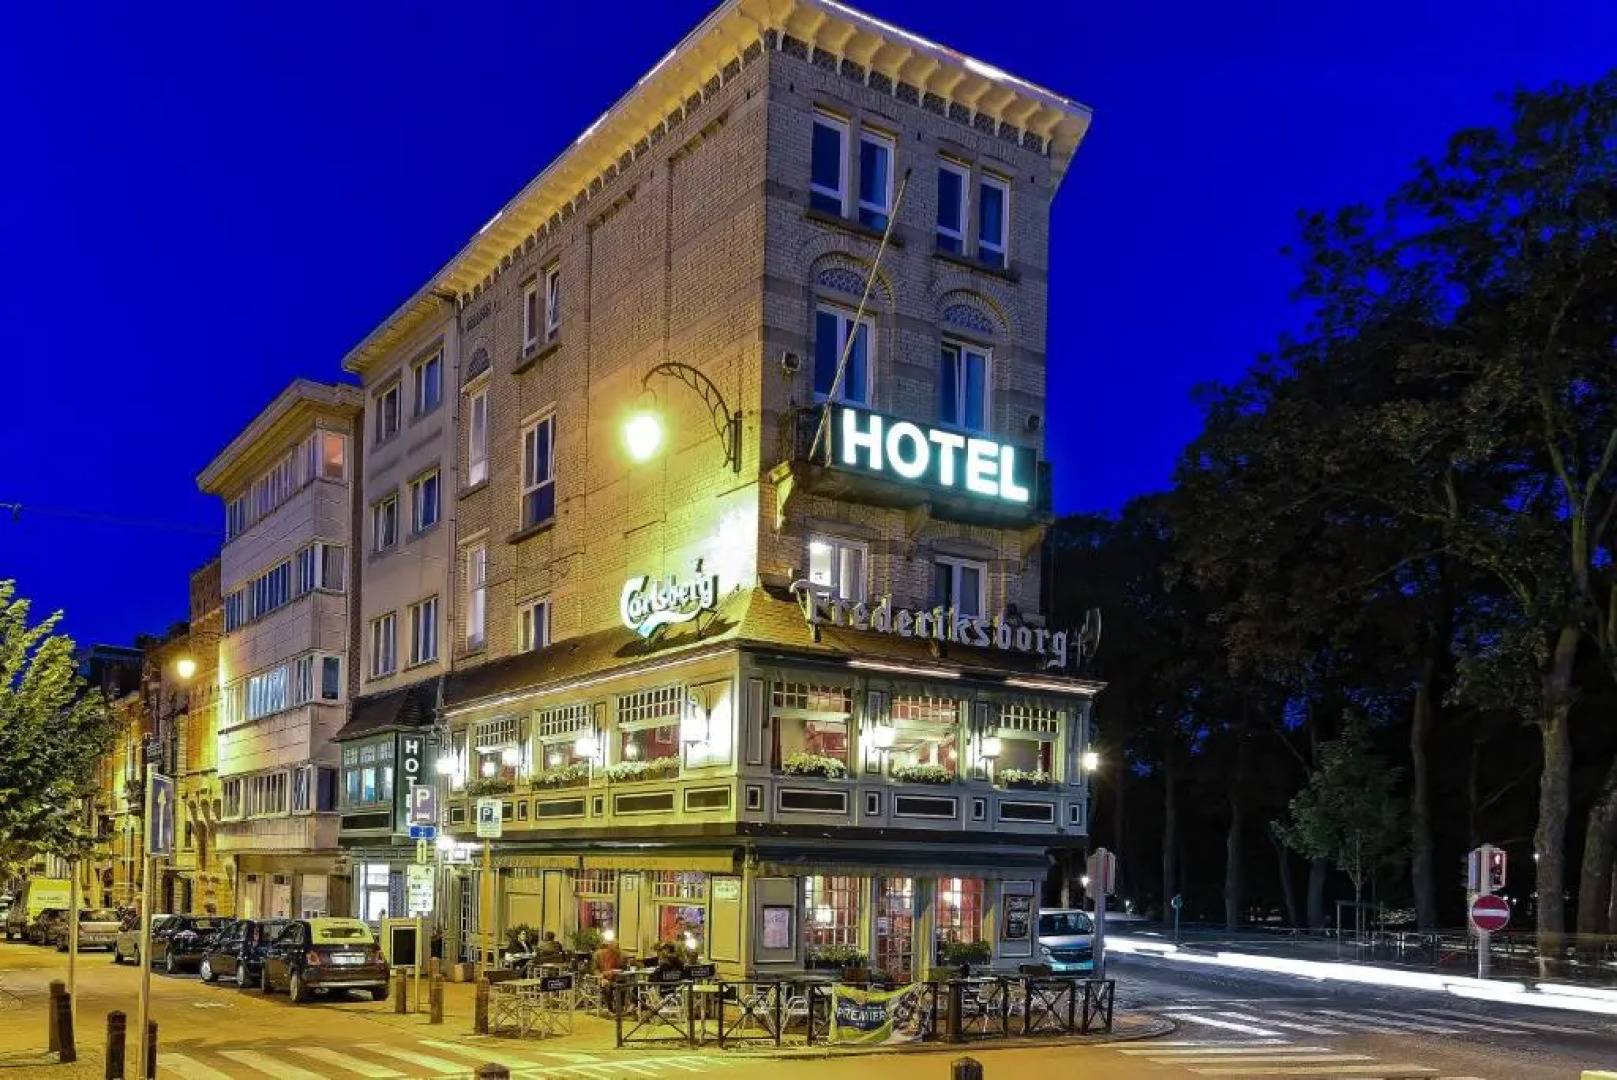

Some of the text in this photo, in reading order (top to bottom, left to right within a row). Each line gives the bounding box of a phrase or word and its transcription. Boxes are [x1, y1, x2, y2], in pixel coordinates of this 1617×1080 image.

[843, 409, 1029, 502] HOTEL
[620, 574, 714, 632] Carlsberg
[790, 579, 1068, 668] Frederiksborg
[417, 788, 430, 807] P
[482, 807, 492, 821] P
